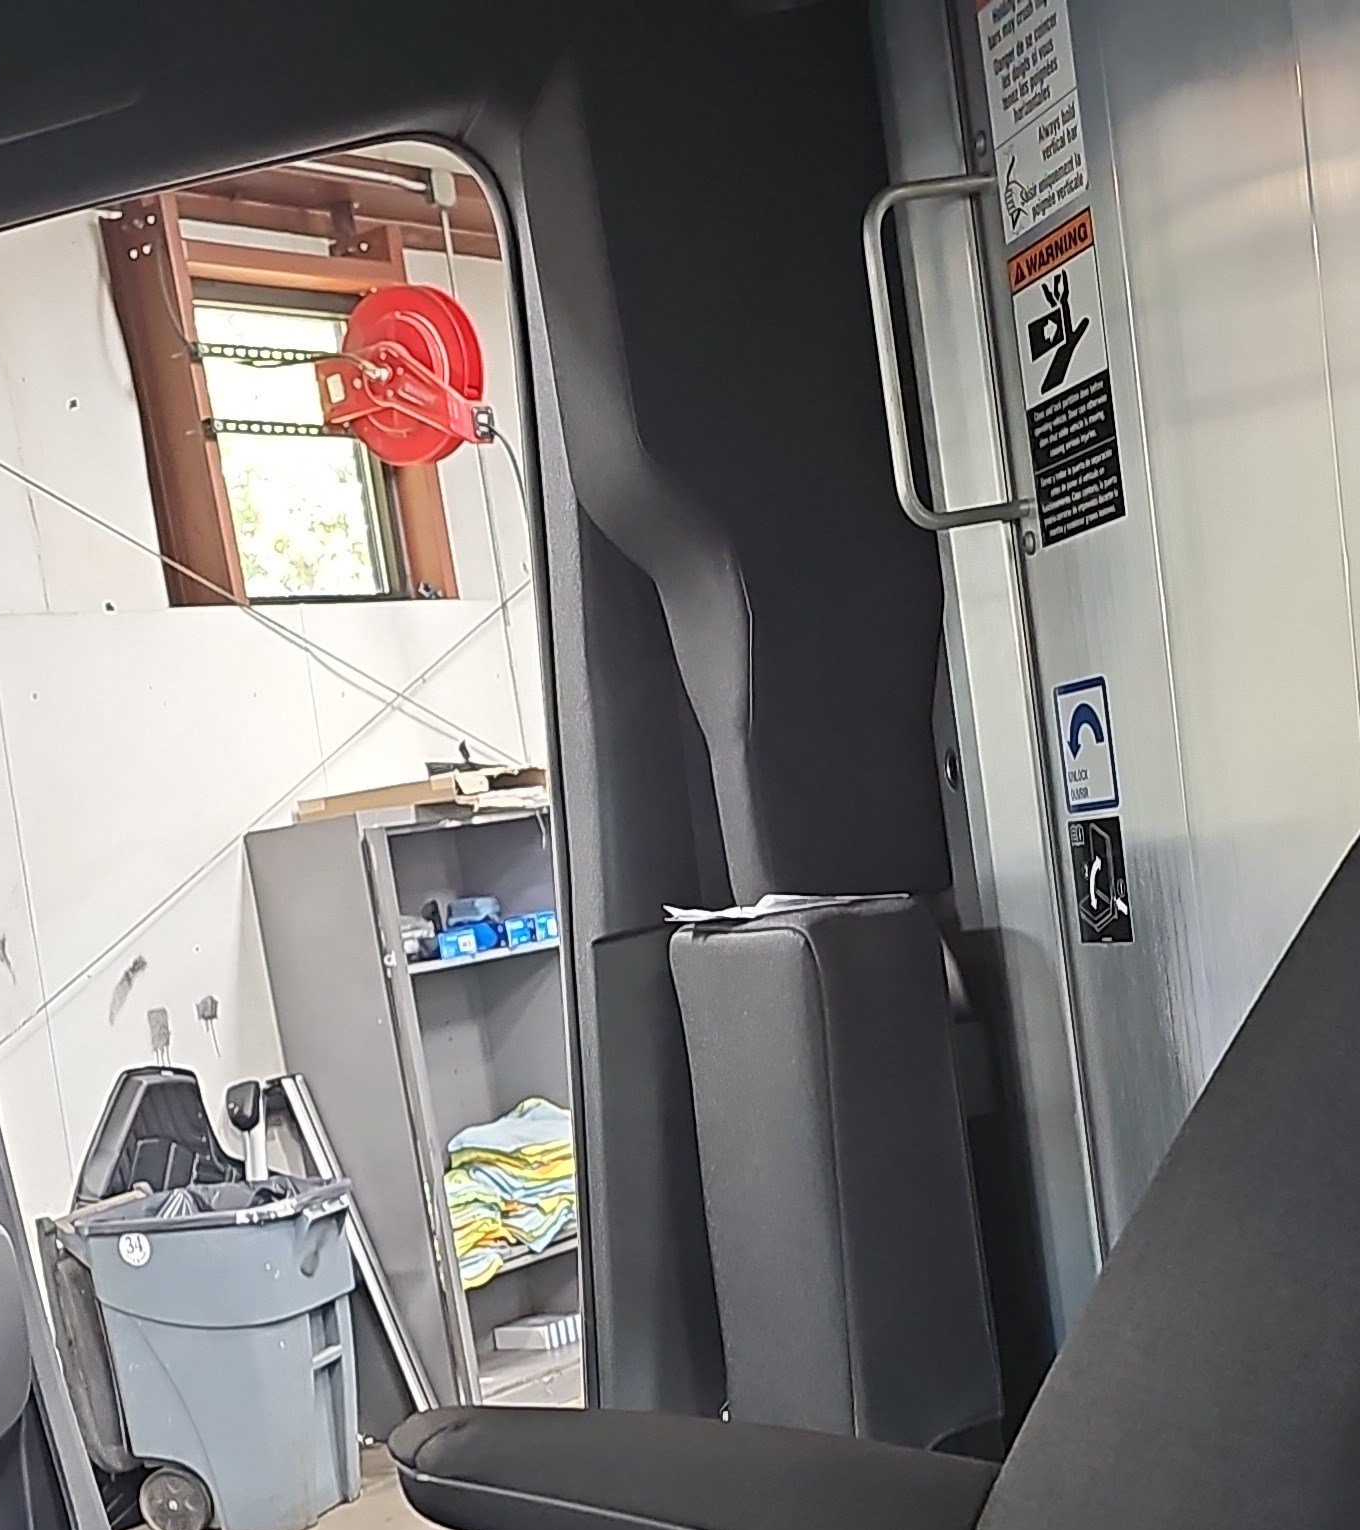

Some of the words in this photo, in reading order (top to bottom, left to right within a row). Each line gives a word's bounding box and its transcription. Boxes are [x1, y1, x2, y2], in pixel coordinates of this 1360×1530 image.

[1039, 116, 1061, 144] Always
[1041, 130, 1066, 161] vertical
[1026, 222, 1088, 276] WARNING
